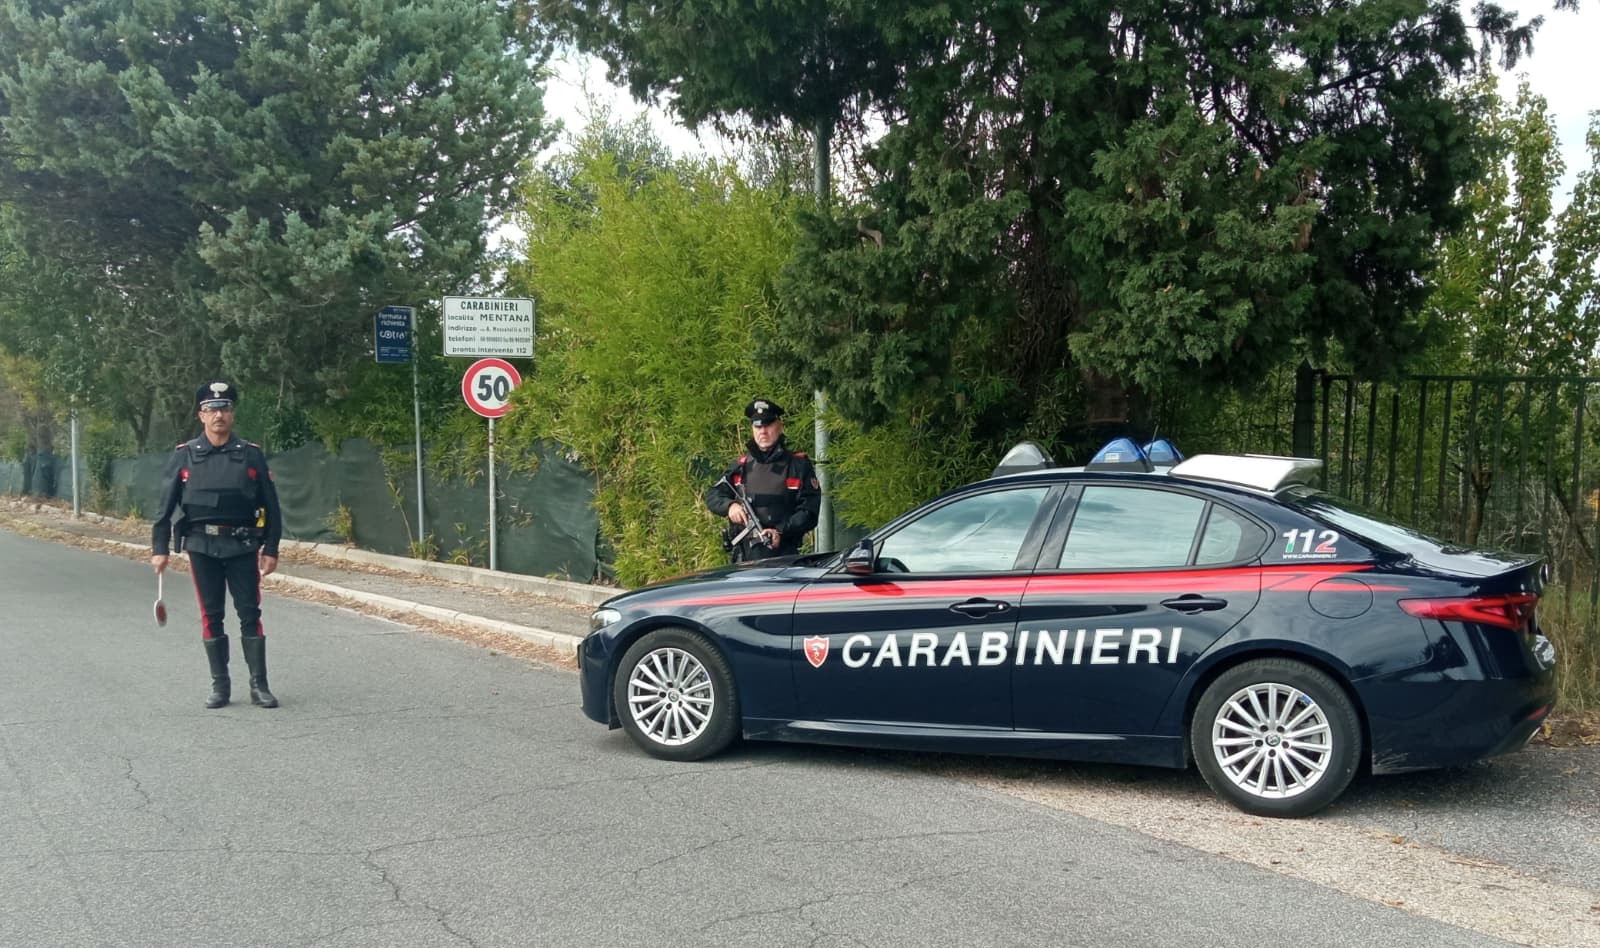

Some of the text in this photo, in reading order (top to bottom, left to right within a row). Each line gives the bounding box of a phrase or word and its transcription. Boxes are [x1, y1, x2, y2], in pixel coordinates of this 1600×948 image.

[460, 301, 518, 311] CARABINIERI
[480, 313, 530, 322] MENTANA
[477, 374, 510, 402] 50
[1282, 528, 1340, 553] 112
[841, 626, 1183, 669] CARABINIERI
